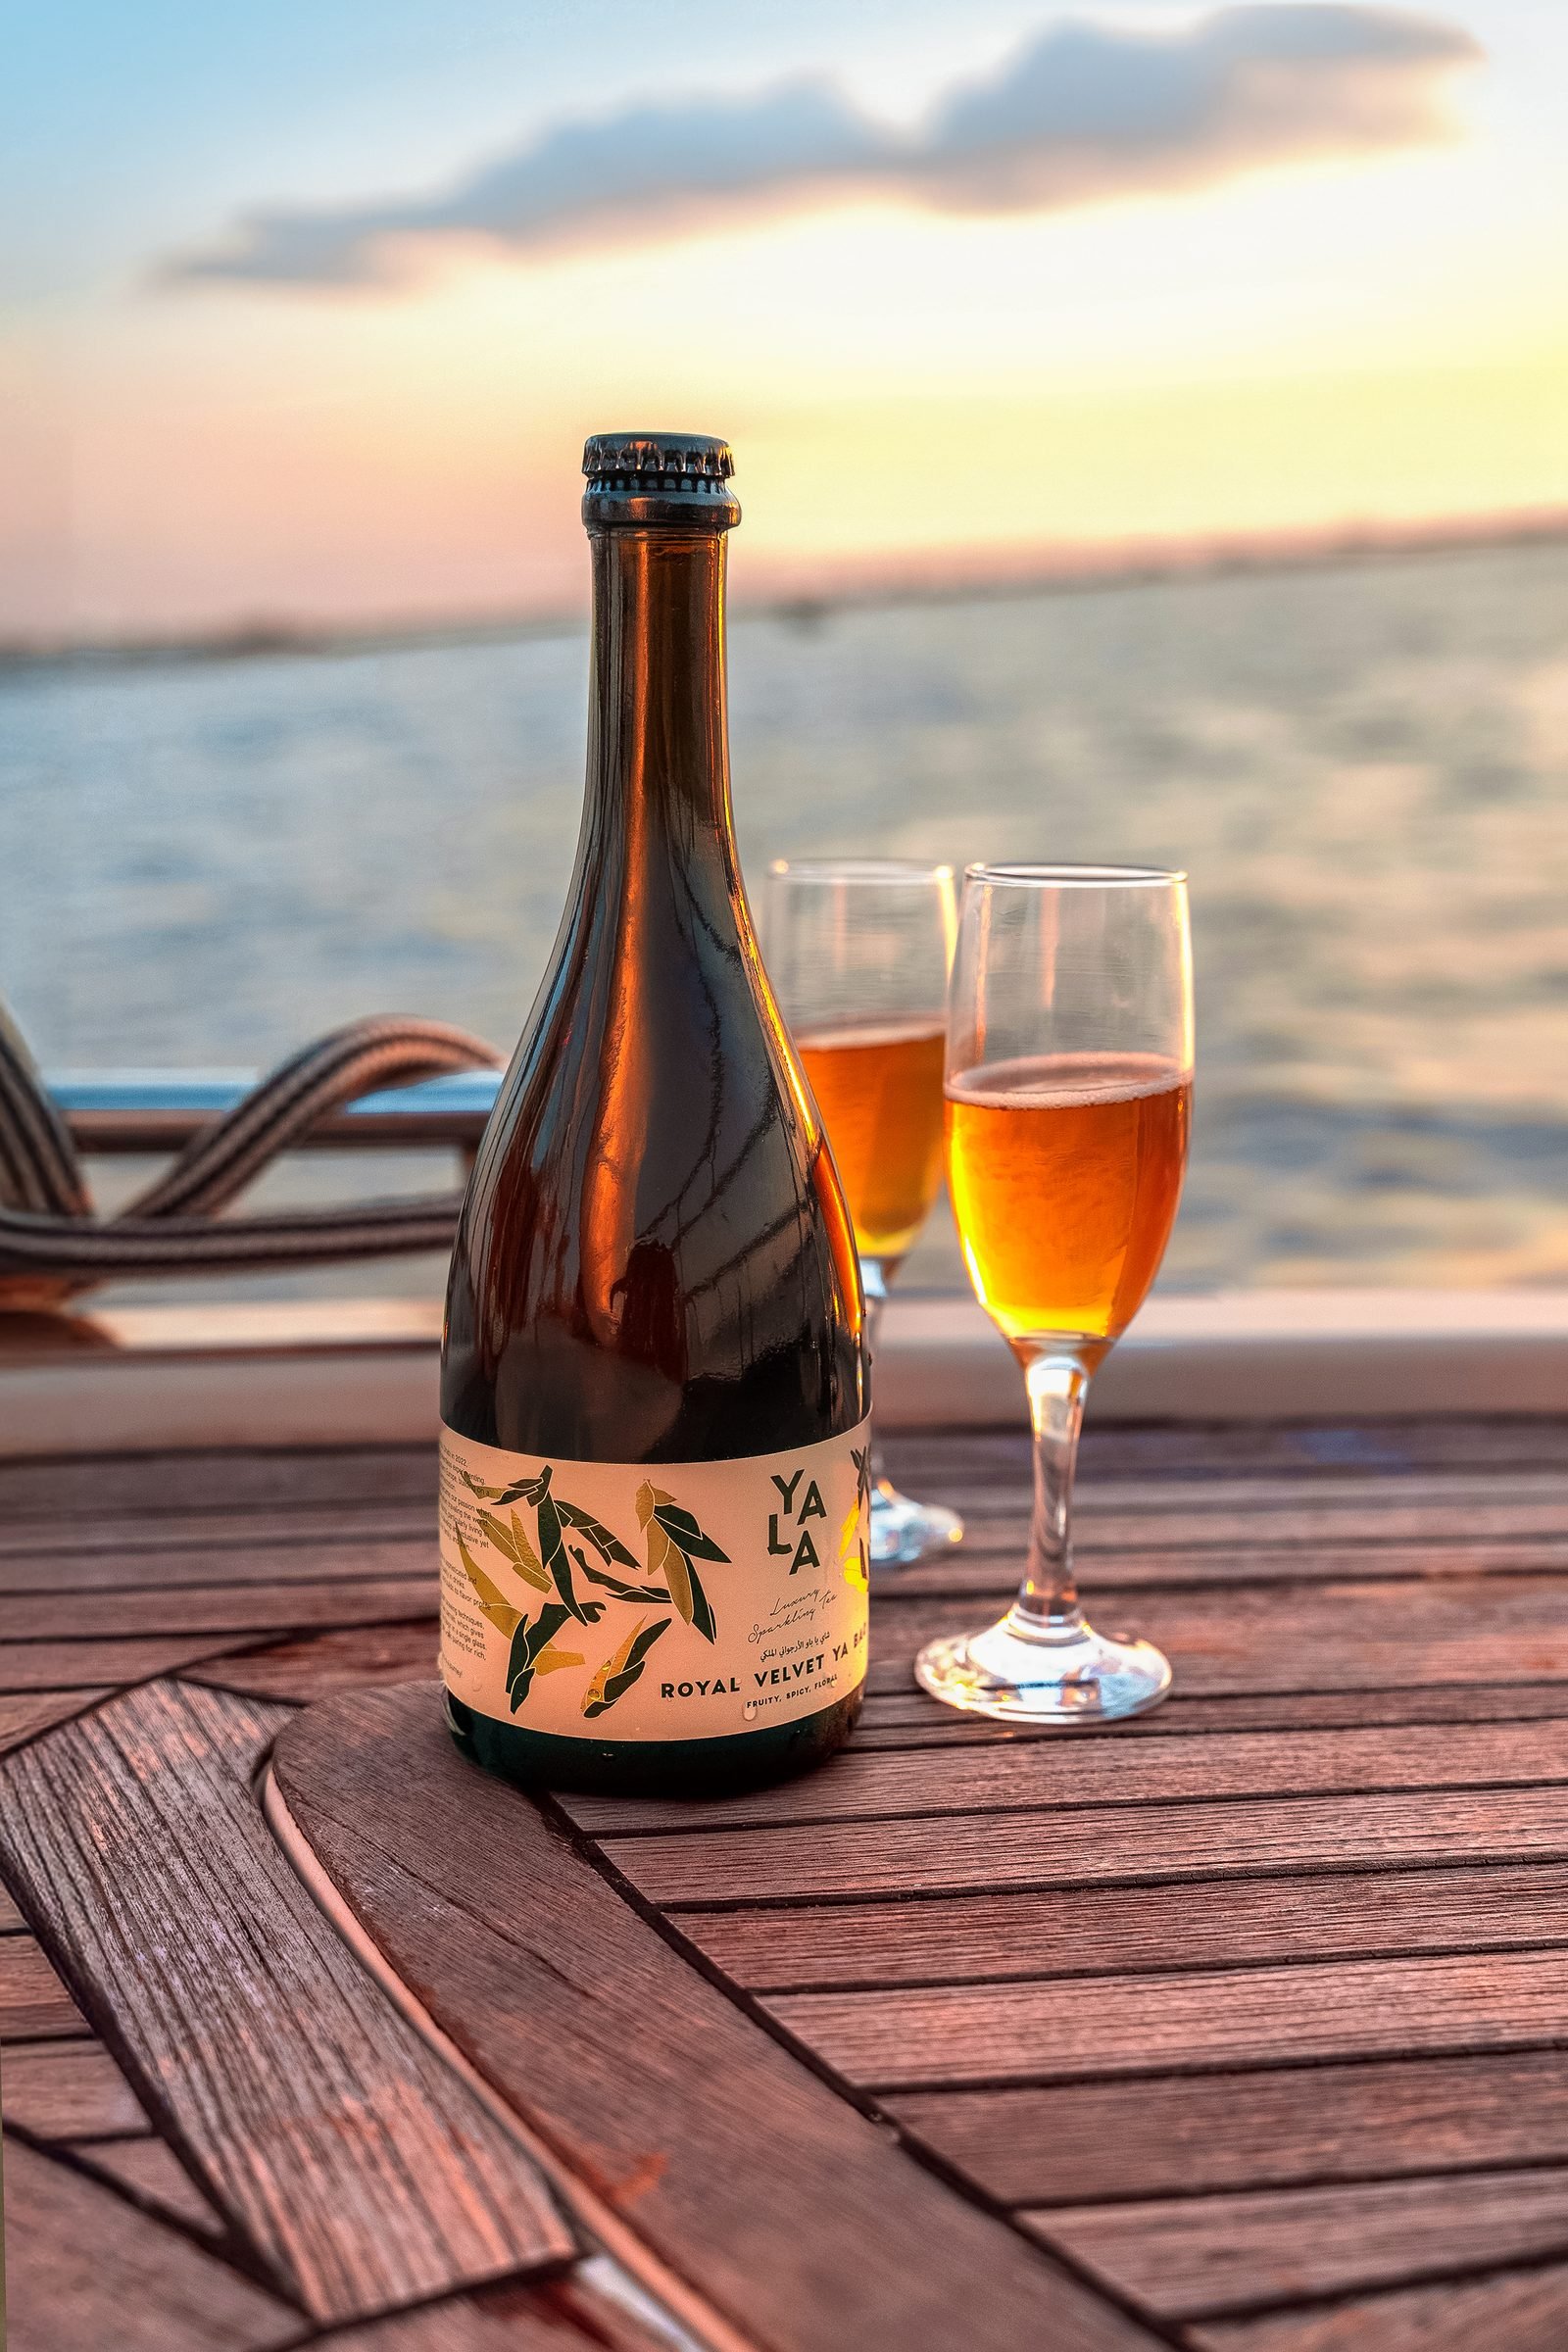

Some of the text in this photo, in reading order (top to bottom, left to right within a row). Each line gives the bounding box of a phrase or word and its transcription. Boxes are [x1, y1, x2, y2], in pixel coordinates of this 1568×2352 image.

[770, 1469, 827, 1525] YA
[767, 1514, 820, 1575] LA
[748, 1607, 815, 1644] Sparkling
[769, 1589, 819, 1616] Luxury
[661, 1677, 740, 1698] ROYAL
[754, 1653, 825, 1688] VELVET
[832, 1642, 849, 1662] YA
[746, 1674, 838, 1708] FRUITY, SPICY, FLORAL
